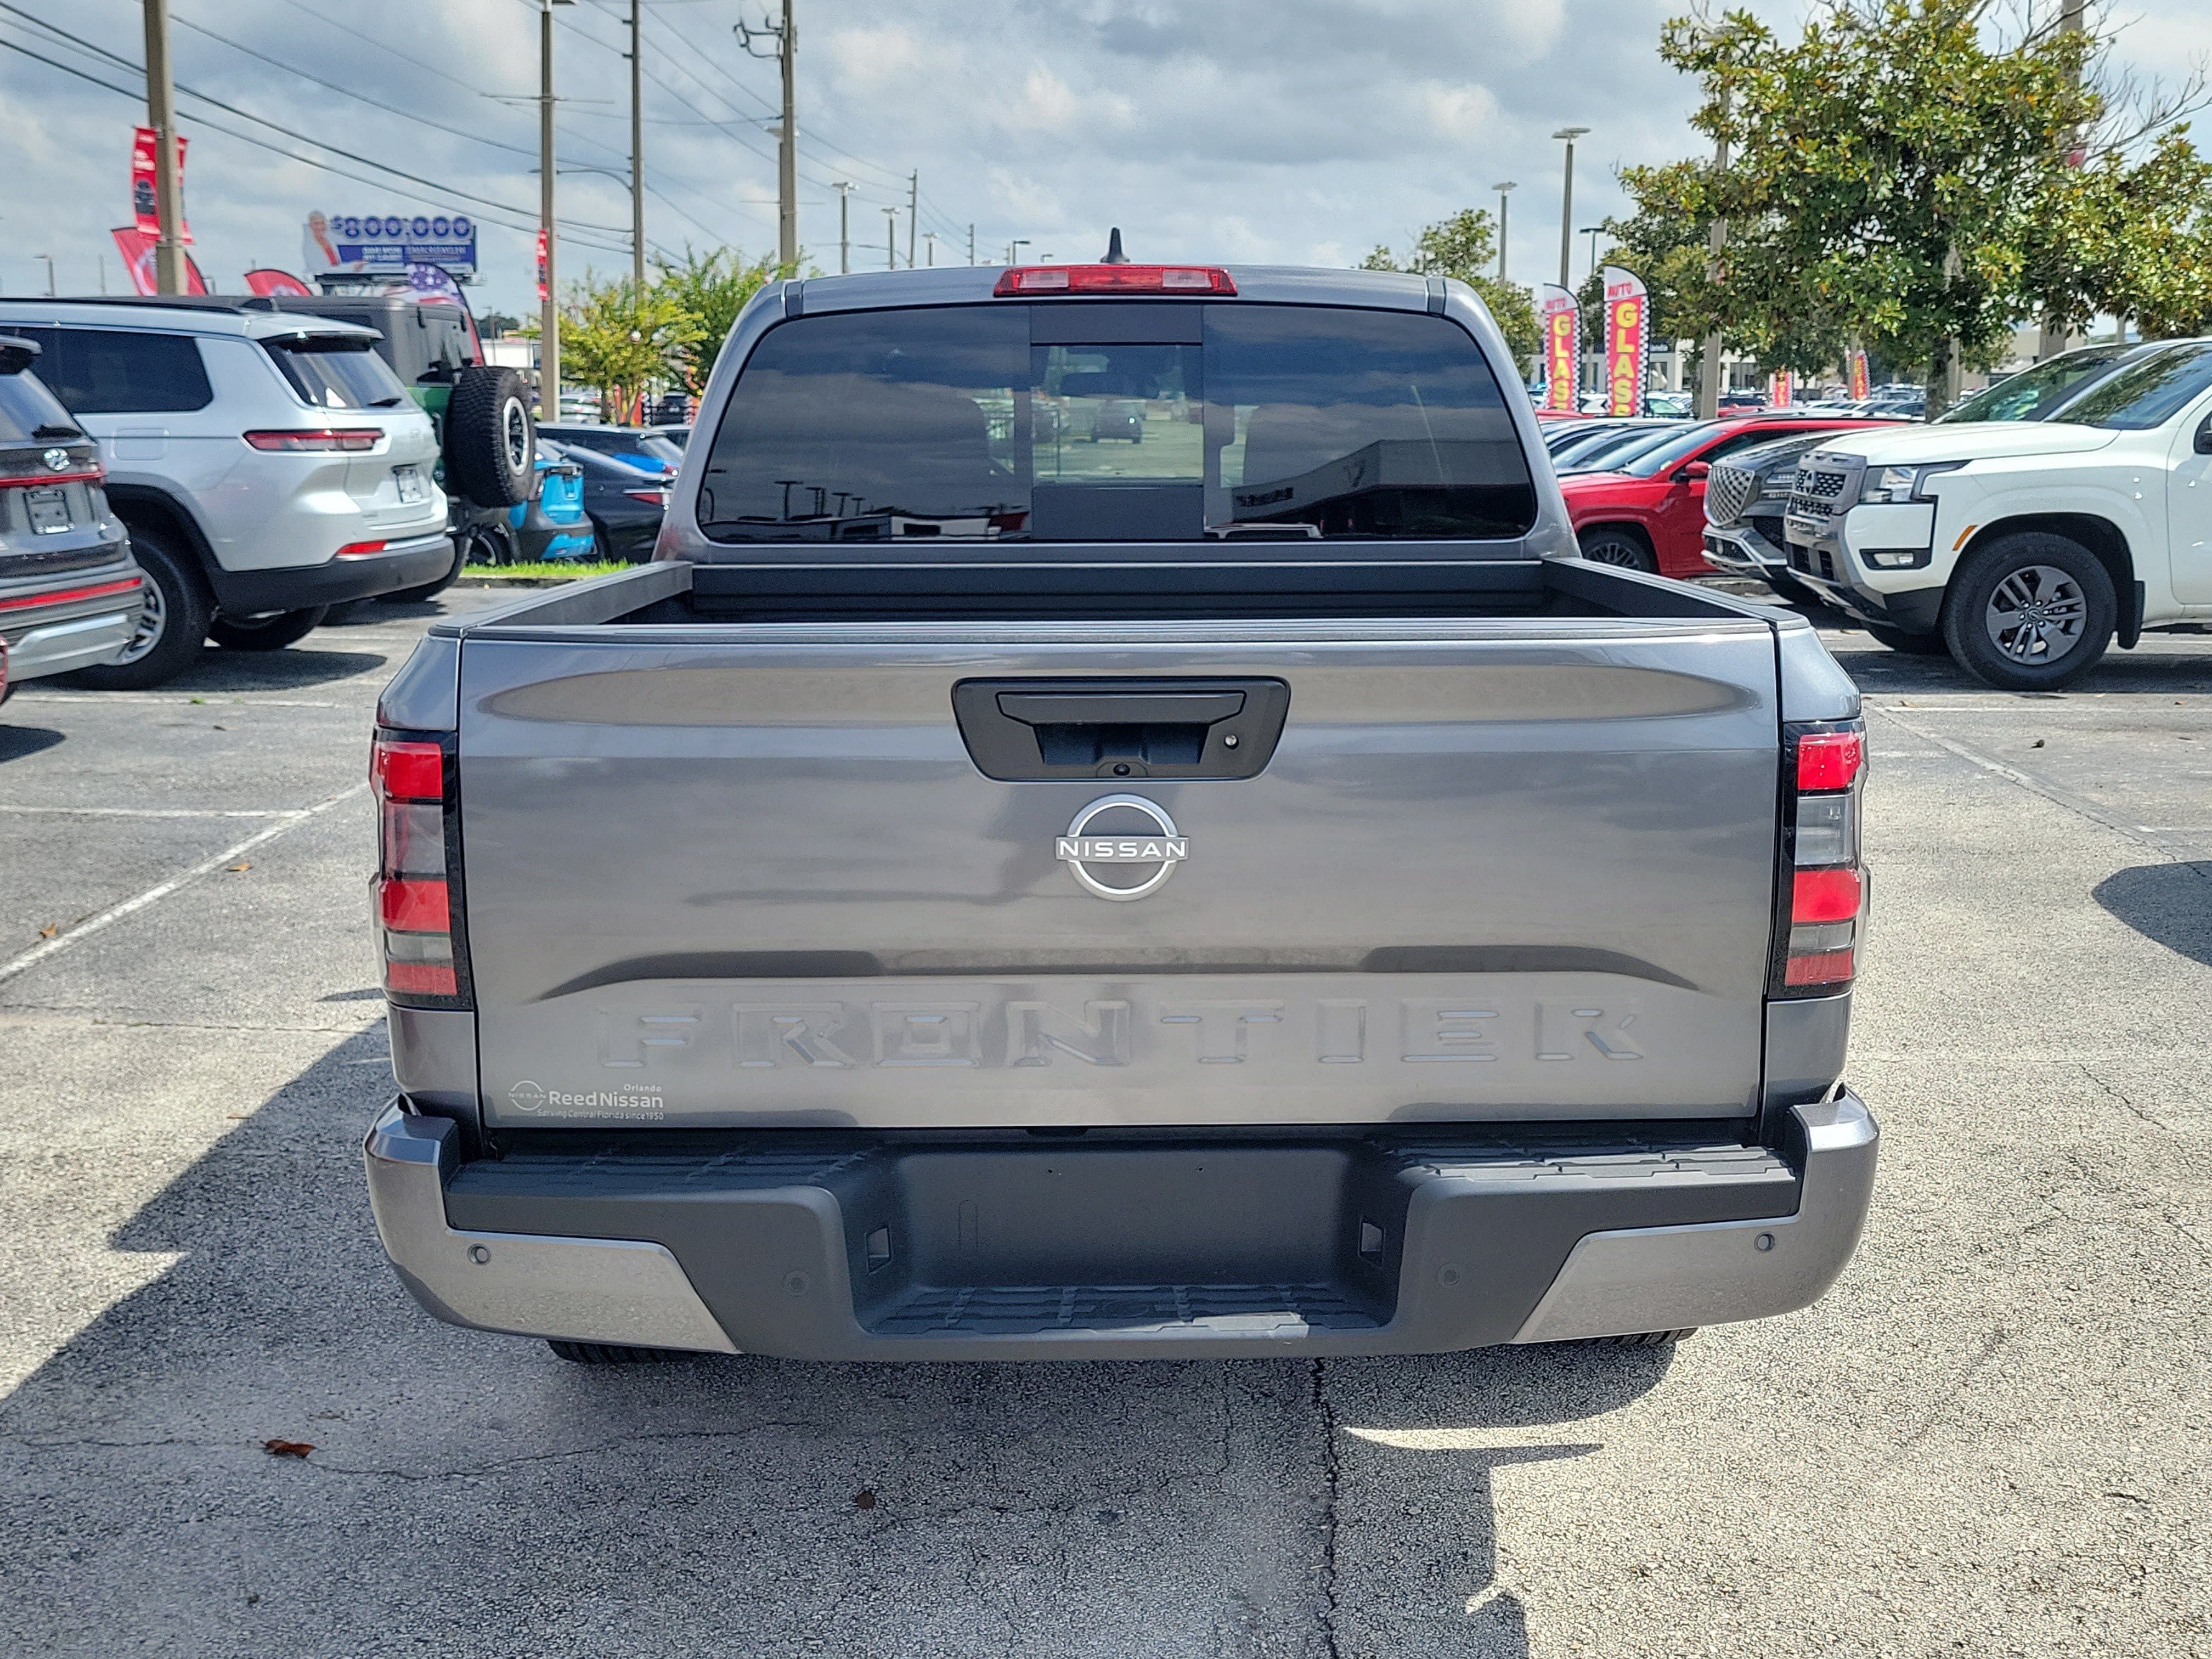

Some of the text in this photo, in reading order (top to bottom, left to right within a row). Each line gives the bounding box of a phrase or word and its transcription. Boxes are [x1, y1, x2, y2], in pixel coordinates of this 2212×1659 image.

[1059, 840, 1186, 857] NISSAN
[599, 998, 1645, 1068] FRONTIER
[624, 1083, 662, 1092] Orlando
[549, 1090, 664, 1108] Reed Nissan
